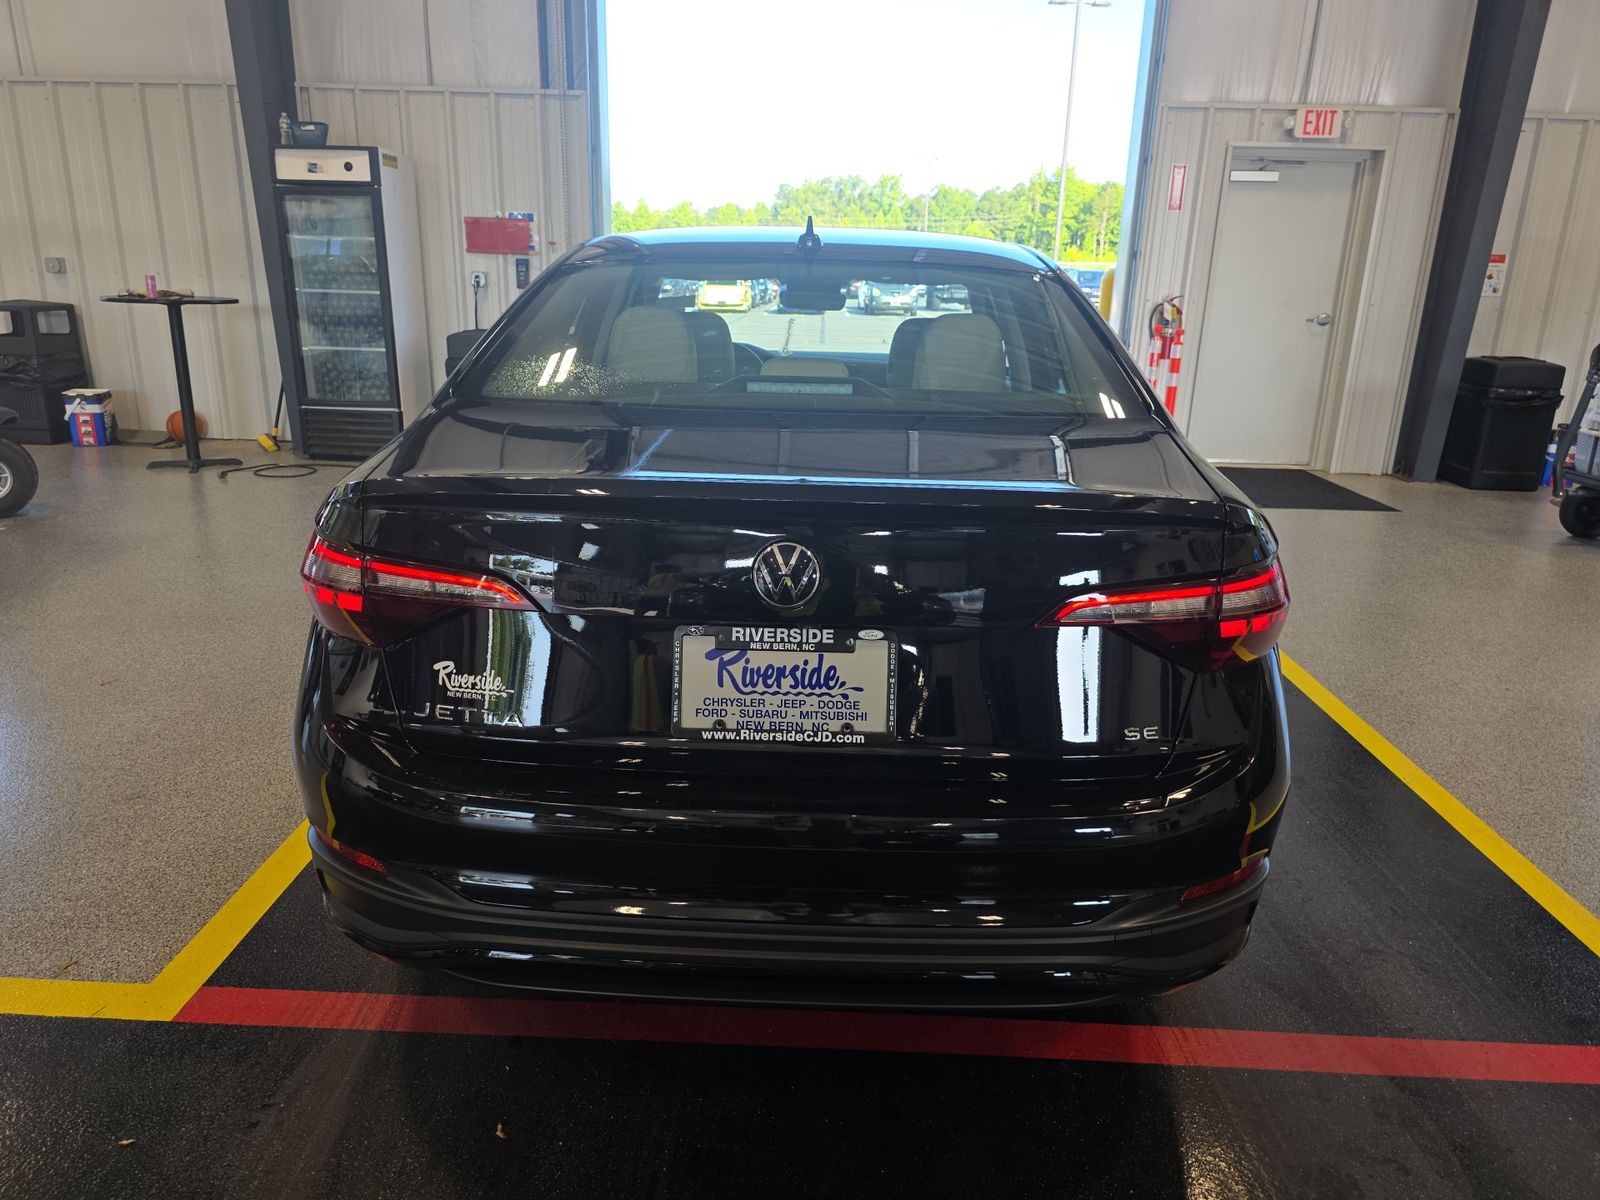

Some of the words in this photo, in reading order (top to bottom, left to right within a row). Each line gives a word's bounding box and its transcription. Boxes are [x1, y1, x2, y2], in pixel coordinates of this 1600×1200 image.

[1302, 109, 1338, 136] EXIT
[731, 627, 834, 643] RIVERSIDE
[773, 642, 800, 651] BERN,
[433, 660, 507, 695] Riverside
[705, 650, 846, 694] Riverside
[463, 692, 484, 701] BERN,
[703, 697, 766, 708] CHRYSLER
[777, 700, 806, 709] JEEP
[817, 700, 860, 710] DODGE
[414, 702, 524, 728] JETTA
[696, 708, 727, 718] FORD
[739, 709, 787, 719] SUBARU
[799, 710, 867, 721] MITSUBISHI
[736, 720, 765, 731] NEW
[811, 722, 830, 732] NC
[1124, 726, 1159, 741] SE
[702, 729, 864, 744] www.RiversideCJD.com
